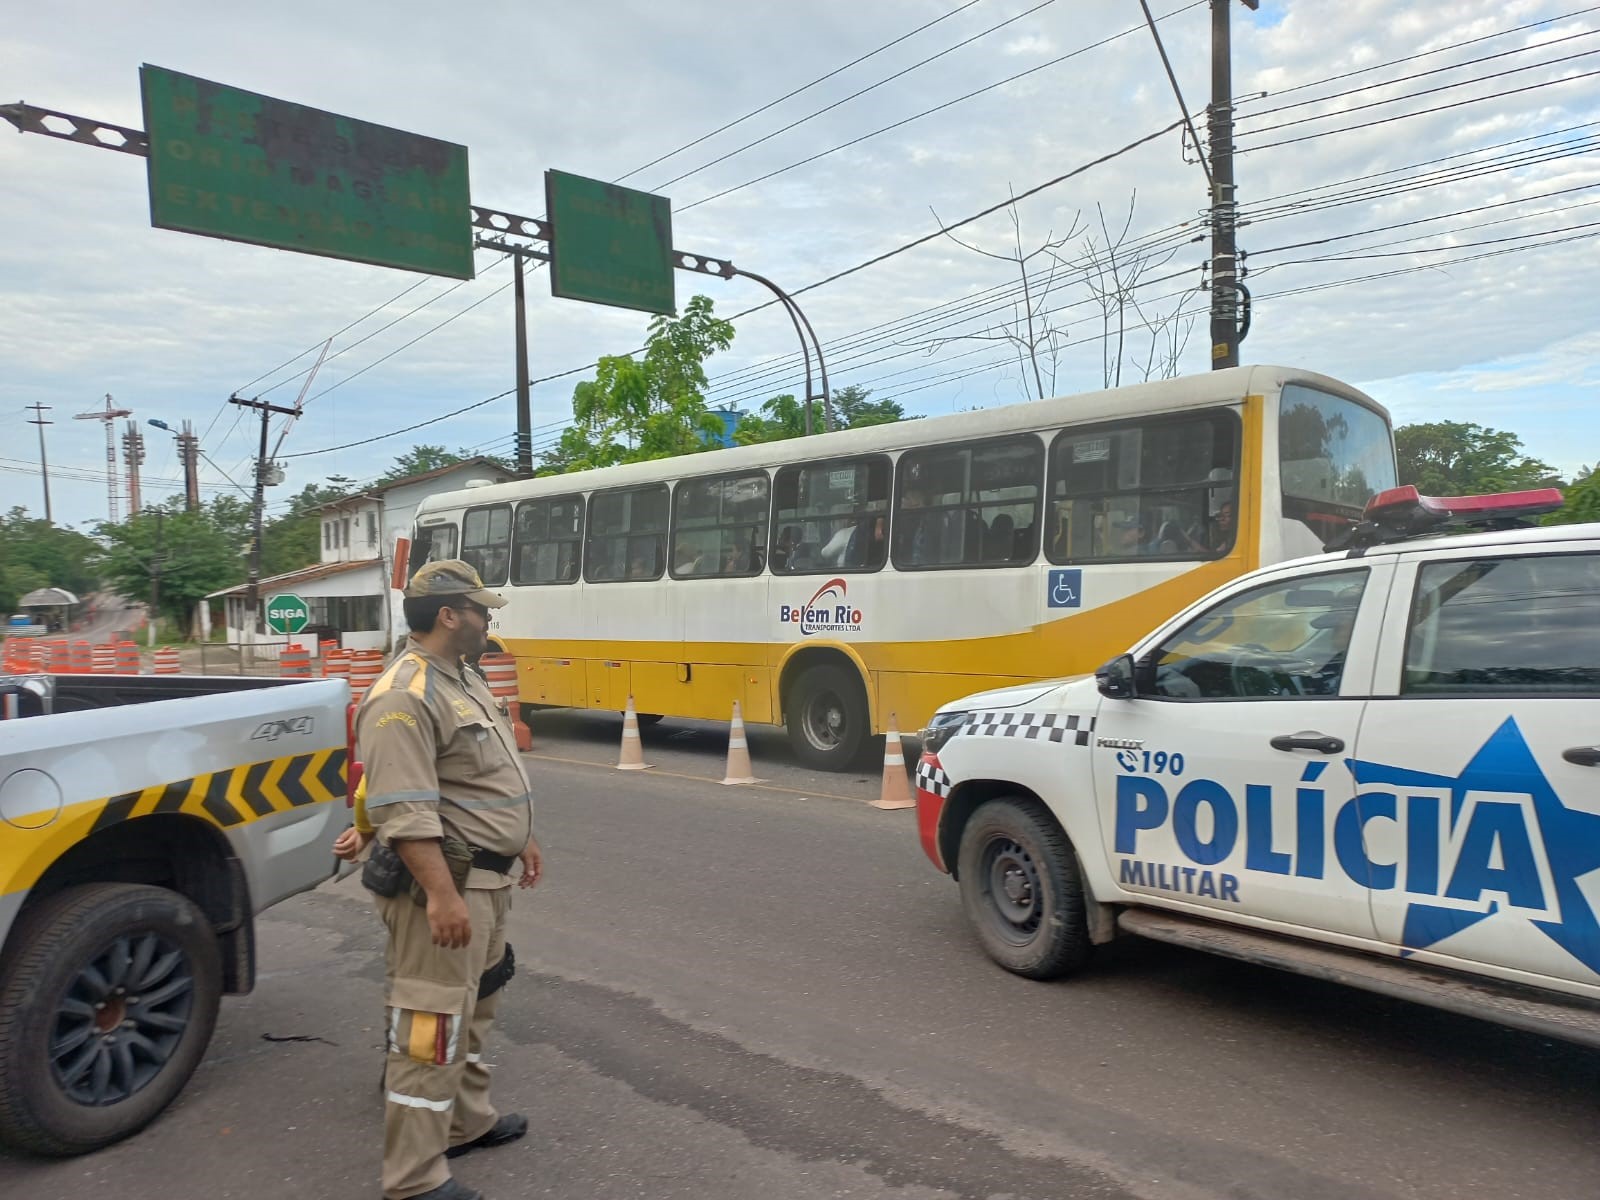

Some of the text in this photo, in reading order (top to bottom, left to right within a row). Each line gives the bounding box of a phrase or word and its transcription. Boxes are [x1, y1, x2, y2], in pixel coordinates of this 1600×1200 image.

[270, 608, 305, 619] SIGA
[780, 604, 862, 624] Belém Rio
[805, 623, 844, 632] TRANSPORTES
[1142, 750, 1184, 776] 190
[1115, 761, 1547, 911] POLÍCIA
[1119, 858, 1240, 903] MILITAR
